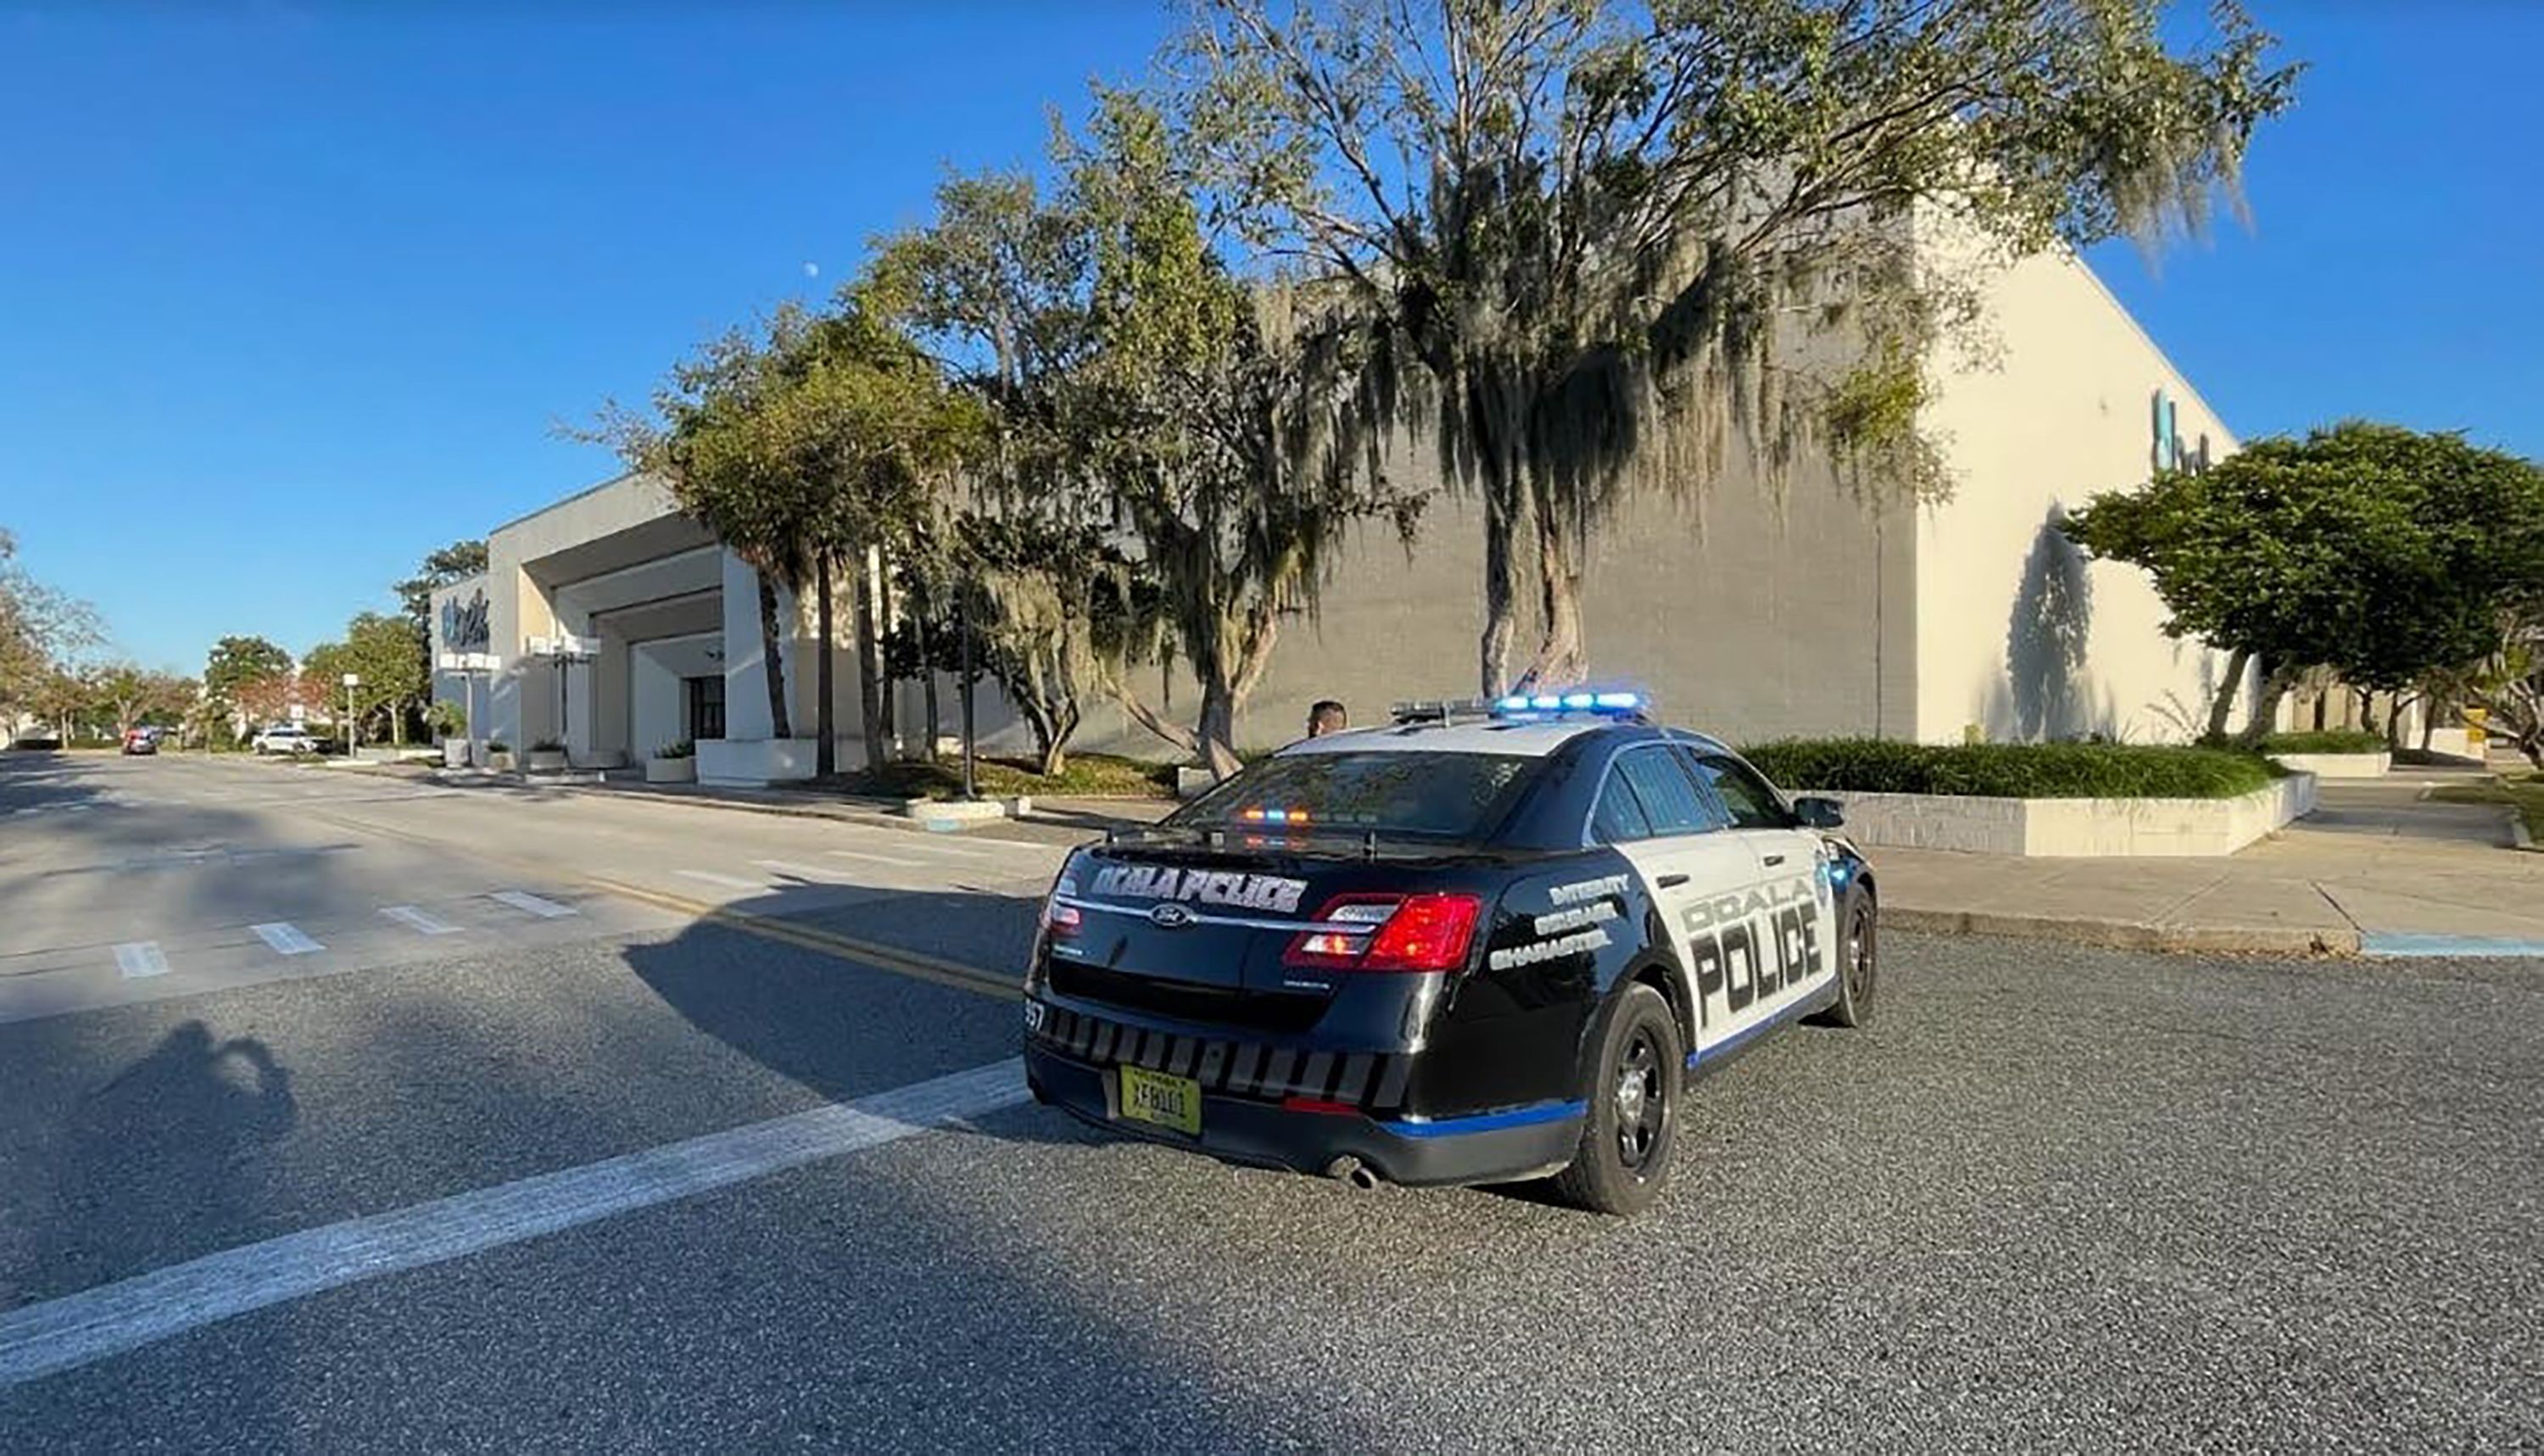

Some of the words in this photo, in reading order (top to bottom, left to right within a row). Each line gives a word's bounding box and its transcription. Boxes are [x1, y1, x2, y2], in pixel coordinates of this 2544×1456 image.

[1177, 867, 1308, 913] POLICE
[1681, 879, 1814, 933] OCALA
[1689, 901, 1822, 1029] POLICE
